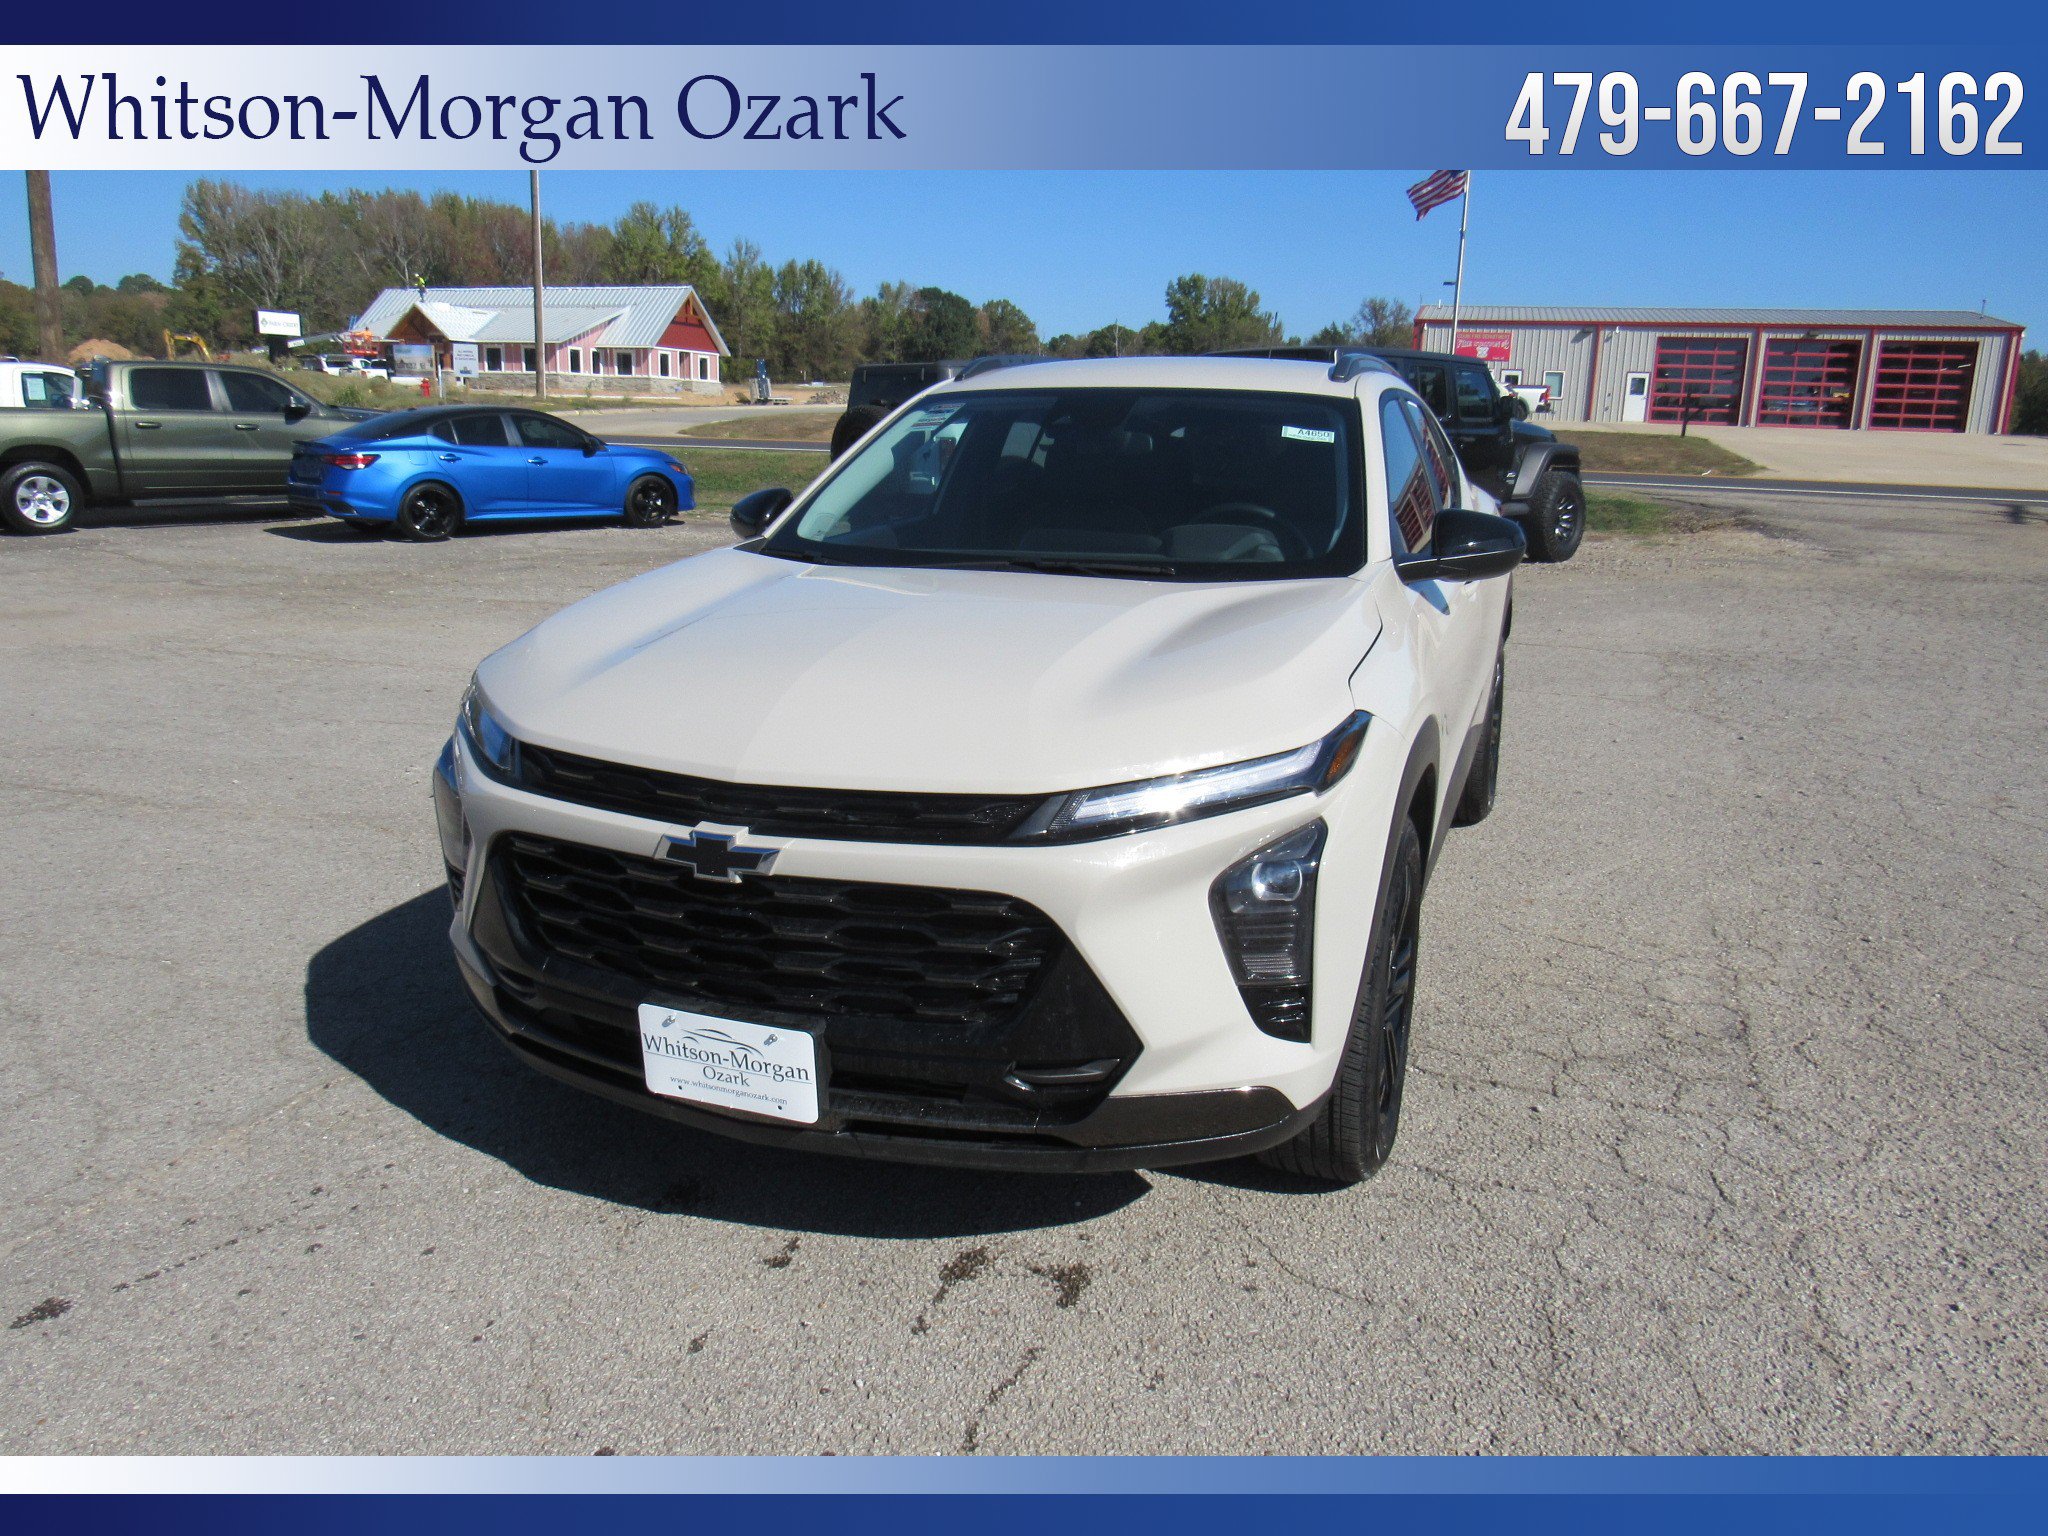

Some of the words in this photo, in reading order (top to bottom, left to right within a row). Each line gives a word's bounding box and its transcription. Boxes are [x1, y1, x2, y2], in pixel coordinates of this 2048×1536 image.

[643, 1032, 810, 1082] Whitson-Morgan
[670, 1076, 788, 1105] www.whitsonmorganozark.com
[702, 1065, 750, 1087] Ozark
